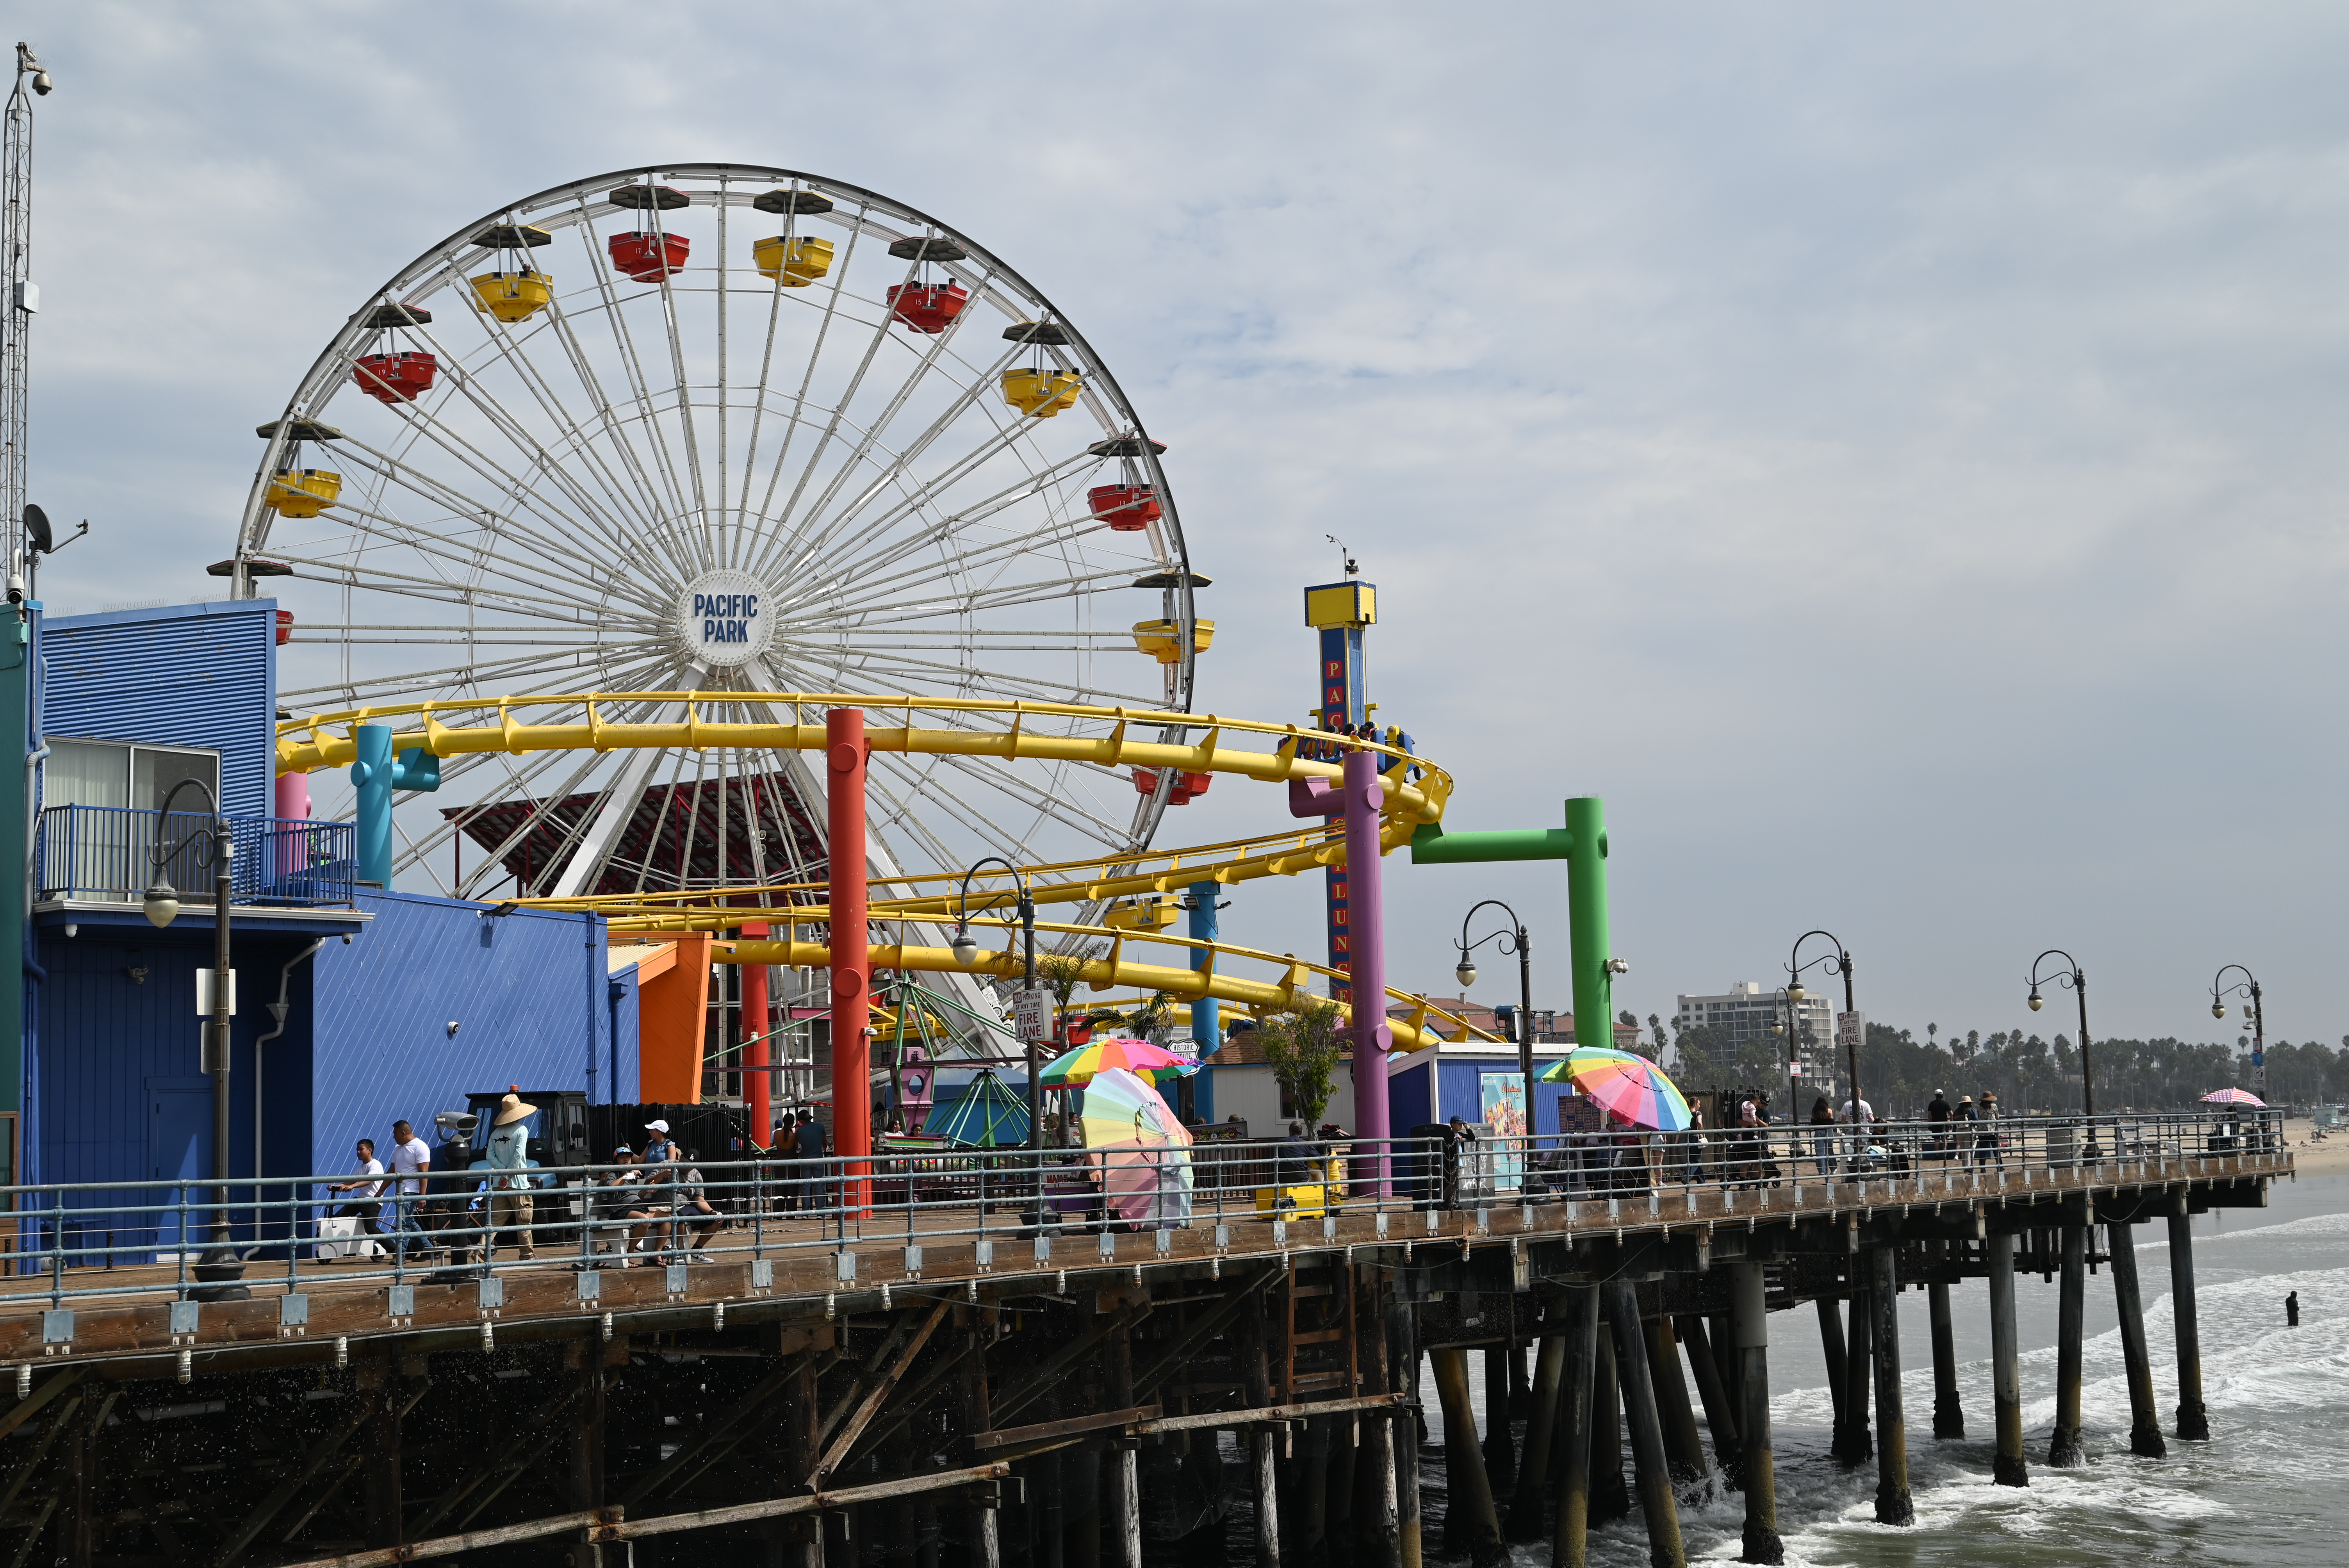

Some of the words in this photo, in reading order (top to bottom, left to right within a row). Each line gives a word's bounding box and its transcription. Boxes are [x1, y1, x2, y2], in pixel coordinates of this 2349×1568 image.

[695, 594, 758, 617] PACIFIC
[705, 620, 748, 642] PARK
[1014, 994, 1021, 1002] NO
[1023, 992, 1041, 1001] PARKING
[1019, 1012, 1039, 1025] FIRE
[1018, 1025, 1042, 1039] LANE
[1842, 1026, 1857, 1035] FIRE
[1841, 1035, 1859, 1044] LANE
[1501, 1082, 1522, 1096] Greetings
[1486, 1097, 1513, 1125] SANTA
